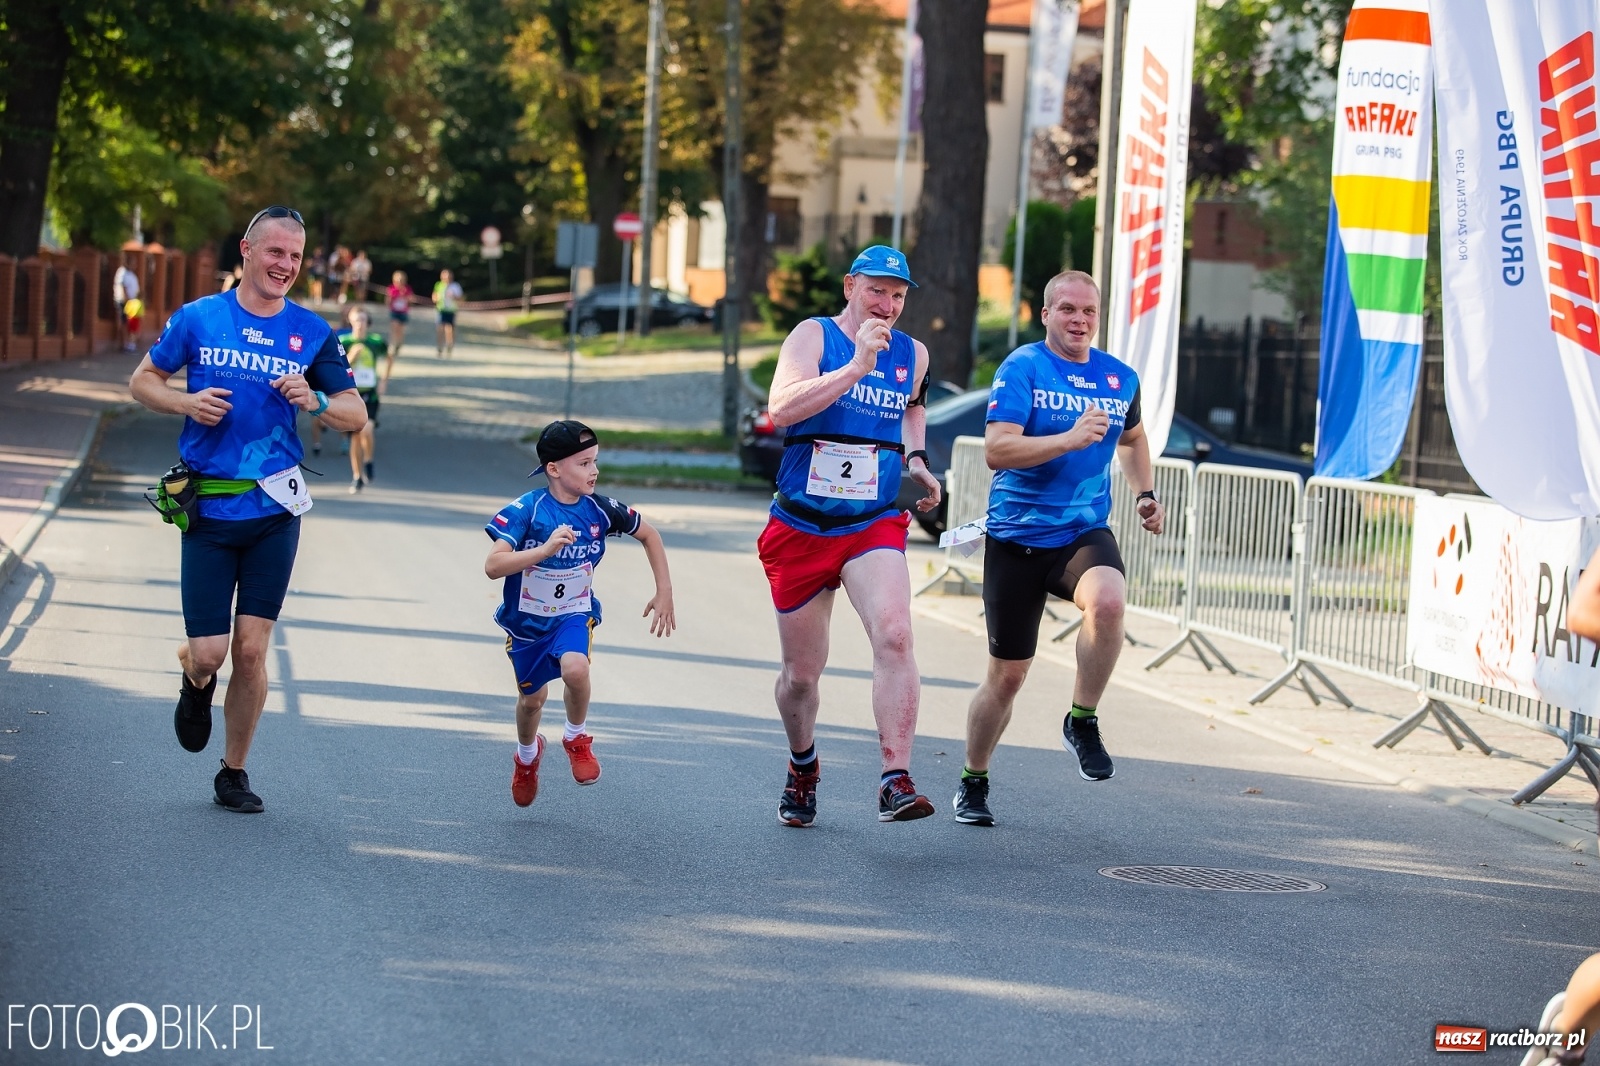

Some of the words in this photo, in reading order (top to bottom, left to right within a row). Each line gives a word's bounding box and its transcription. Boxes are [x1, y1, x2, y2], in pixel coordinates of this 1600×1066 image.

[1346, 66, 1420, 96] fundacja
[1120, 45, 1169, 327] RAFAKO
[843, 383, 911, 411] NNER
[879, 411, 900, 420] TEAM
[1051, 413, 1080, 423] EKO-O
[1109, 419, 1124, 427] EAM
[841, 461, 852, 478] 2
[289, 479, 298, 495] 9
[524, 539, 601, 559] RNES
[554, 583, 565, 599] 8
[1532, 562, 1600, 668] RA
